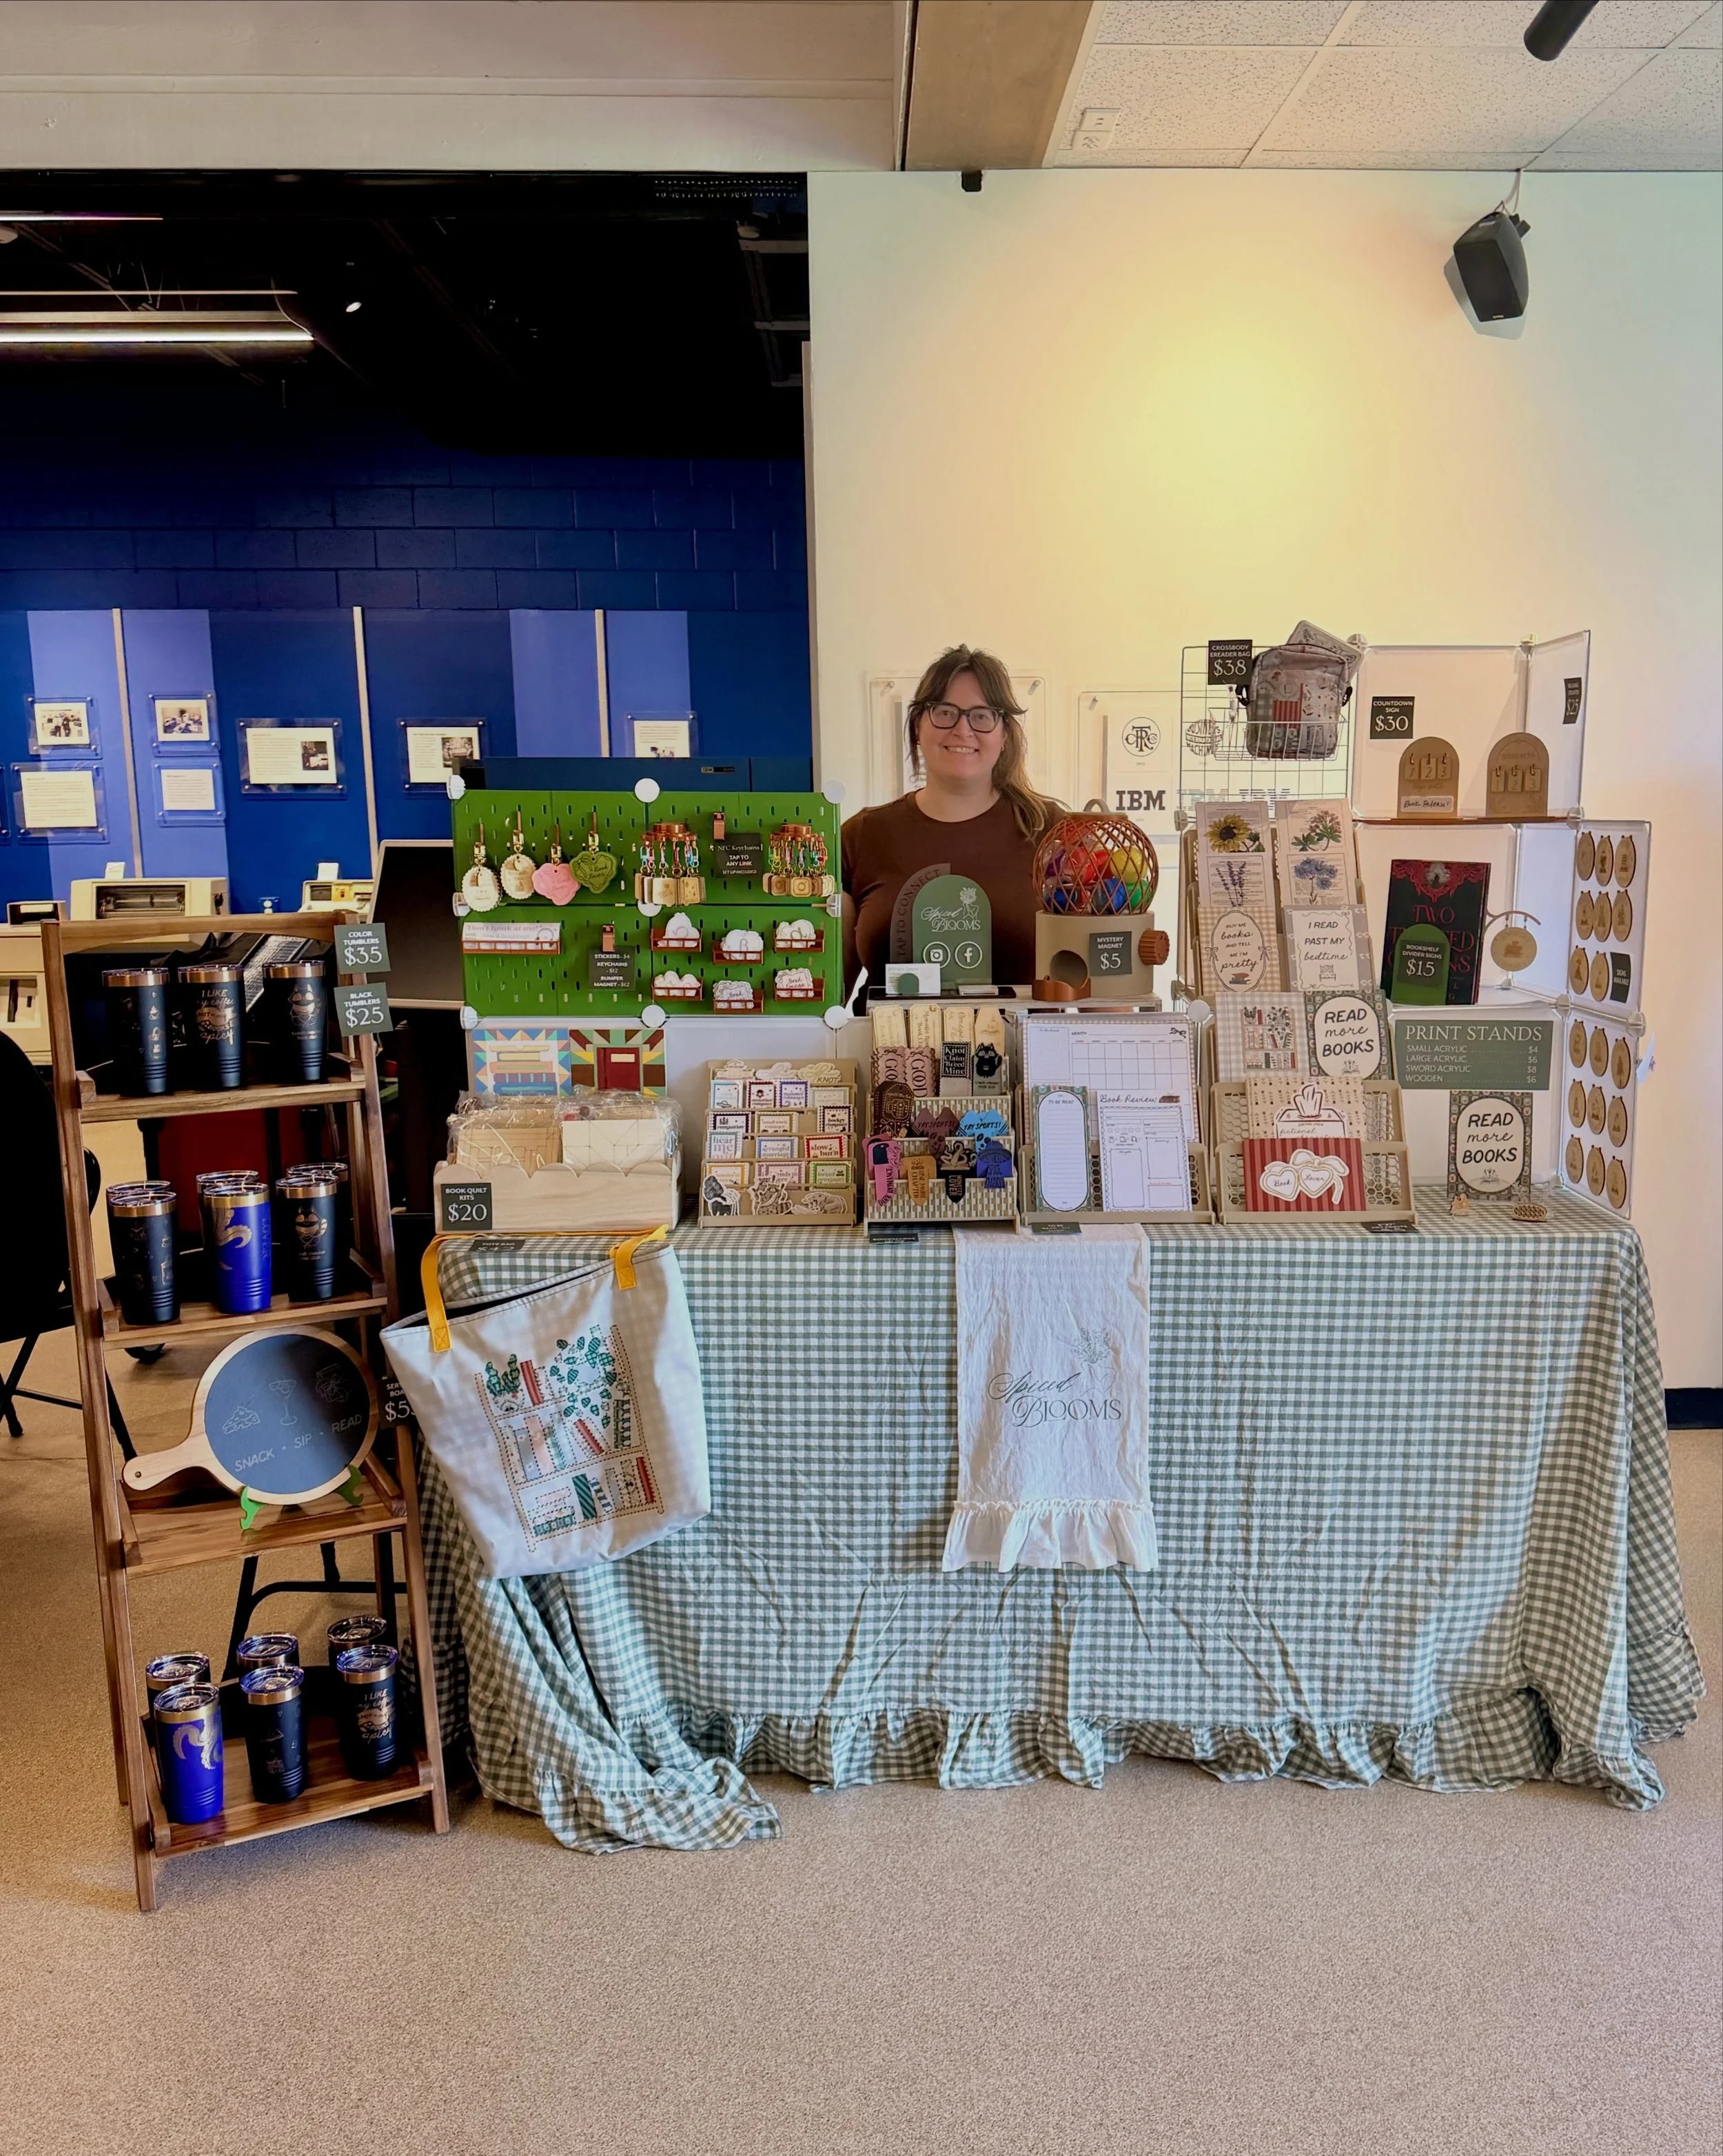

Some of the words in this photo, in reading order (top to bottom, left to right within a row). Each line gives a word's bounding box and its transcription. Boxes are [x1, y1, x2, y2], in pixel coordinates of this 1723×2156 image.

[1214, 658, 1246, 678] $38
[1375, 715, 1409, 732] $30
[1425, 766, 1432, 778] 2
[1440, 766, 1447, 777] 3
[1528, 778, 1536, 790] 3
[1116, 790, 1166, 811] IBM
[897, 868, 940, 915] CONNECT
[1413, 904, 1455, 924] TWO
[898, 919, 906, 936] TO
[931, 918, 981, 932] BLOOMS
[1221, 930, 1254, 940] books
[898, 938, 906, 955] TAP
[1406, 944, 1439, 953] BOOKSHELF
[344, 946, 383, 966] $35
[1100, 952, 1121, 971] $5
[1304, 952, 1348, 961] bedtime
[1221, 959, 1258, 973] pretty
[1406, 958, 1435, 977] $15
[202, 990, 205, 998] I
[207, 989, 228, 997] LIKE
[350, 991, 373, 999] BLACK
[344, 998, 380, 1007] TUMBLERS
[345, 1007, 384, 1028] $25
[1324, 1008, 1367, 1024] READ
[1325, 1026, 1368, 1038] more
[1405, 1026, 1462, 1040] PRINT
[1467, 1026, 1542, 1041] STANDS
[1323, 1039, 1374, 1058] BOOKS
[1434, 1045, 1467, 1053] ACRYLIC
[1529, 1046, 1538, 1054] $4
[1528, 1056, 1538, 1064] $6
[1527, 1066, 1537, 1074] $8
[1527, 1075, 1536, 1084] $6
[1100, 1095, 1122, 1103] Book
[1125, 1095, 1158, 1103] Review
[975, 1121, 1001, 1130] SPORTS!
[1467, 1112, 1513, 1128] READ
[1467, 1132, 1513, 1143] more
[714, 1144, 734, 1154] me
[1462, 1148, 1518, 1164] BOOKS
[949, 1175, 957, 1196] LOVER
[448, 1203, 487, 1223] $20
[988, 1370, 1081, 1403] Spiced
[1012, 1395, 1122, 1427] BLOOMS
[234, 1447, 276, 1472] SNACK
[294, 1433, 313, 1449] SIP
[332, 1414, 363, 1434] READ
[369, 1688, 389, 1700] LIKE
